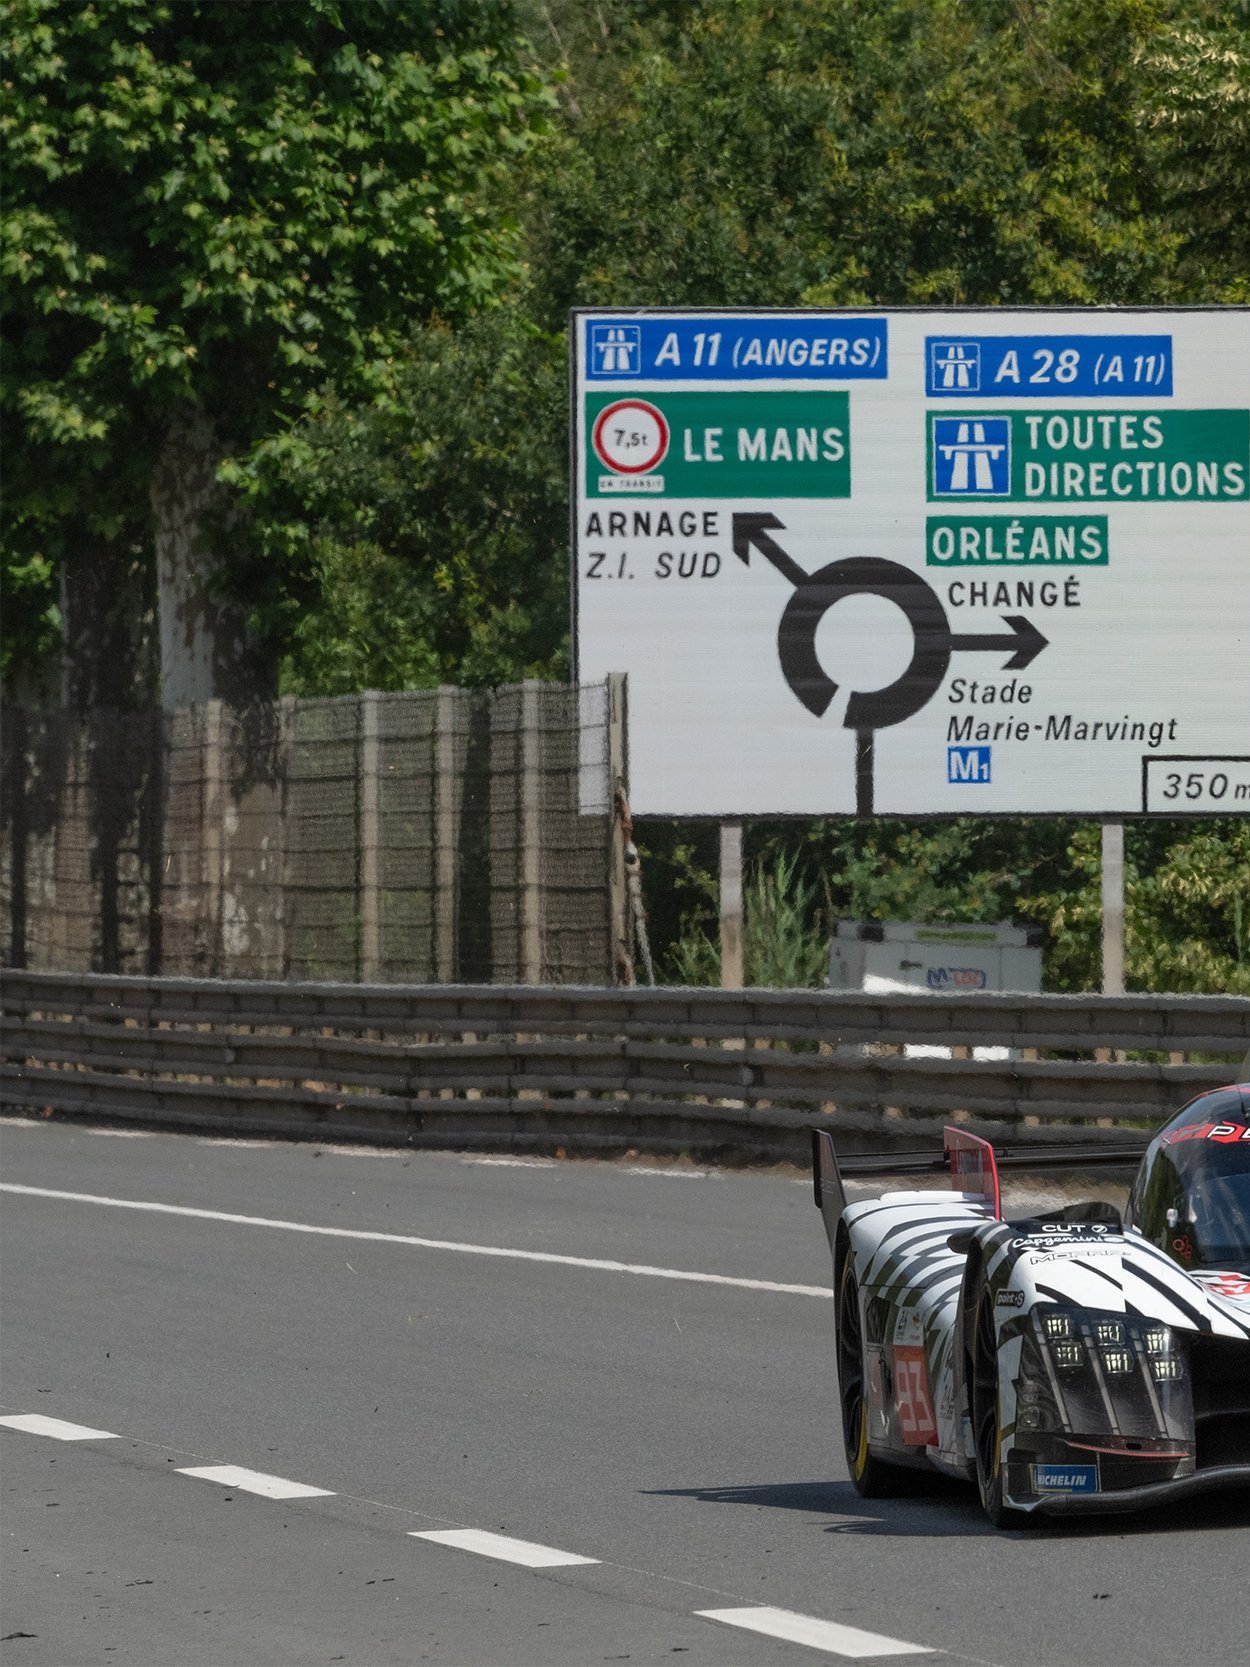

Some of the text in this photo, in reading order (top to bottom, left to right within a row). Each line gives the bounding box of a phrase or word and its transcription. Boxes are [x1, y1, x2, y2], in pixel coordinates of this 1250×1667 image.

[655, 332, 881, 369] A 11 (ANGERS)
[994, 350, 1021, 384] A
[1029, 349, 1081, 384] 28
[613, 429, 648, 449] 7,5t
[684, 427, 845, 462] LE MANS
[1025, 416, 1164, 450] TOUTES
[1025, 462, 1245, 497] DIRECTIONS
[586, 511, 720, 538] ARNAGE
[932, 520, 1103, 561] ORLÉANS
[586, 552, 721, 579] Z.I. SUD
[948, 575, 1081, 607] CHANGÉ
[948, 678, 1033, 704] Stade
[947, 714, 1179, 748] Marie-Marvingt
[1163, 773, 1230, 799] 350
[1013, 1236, 1102, 1248] Capgemini
